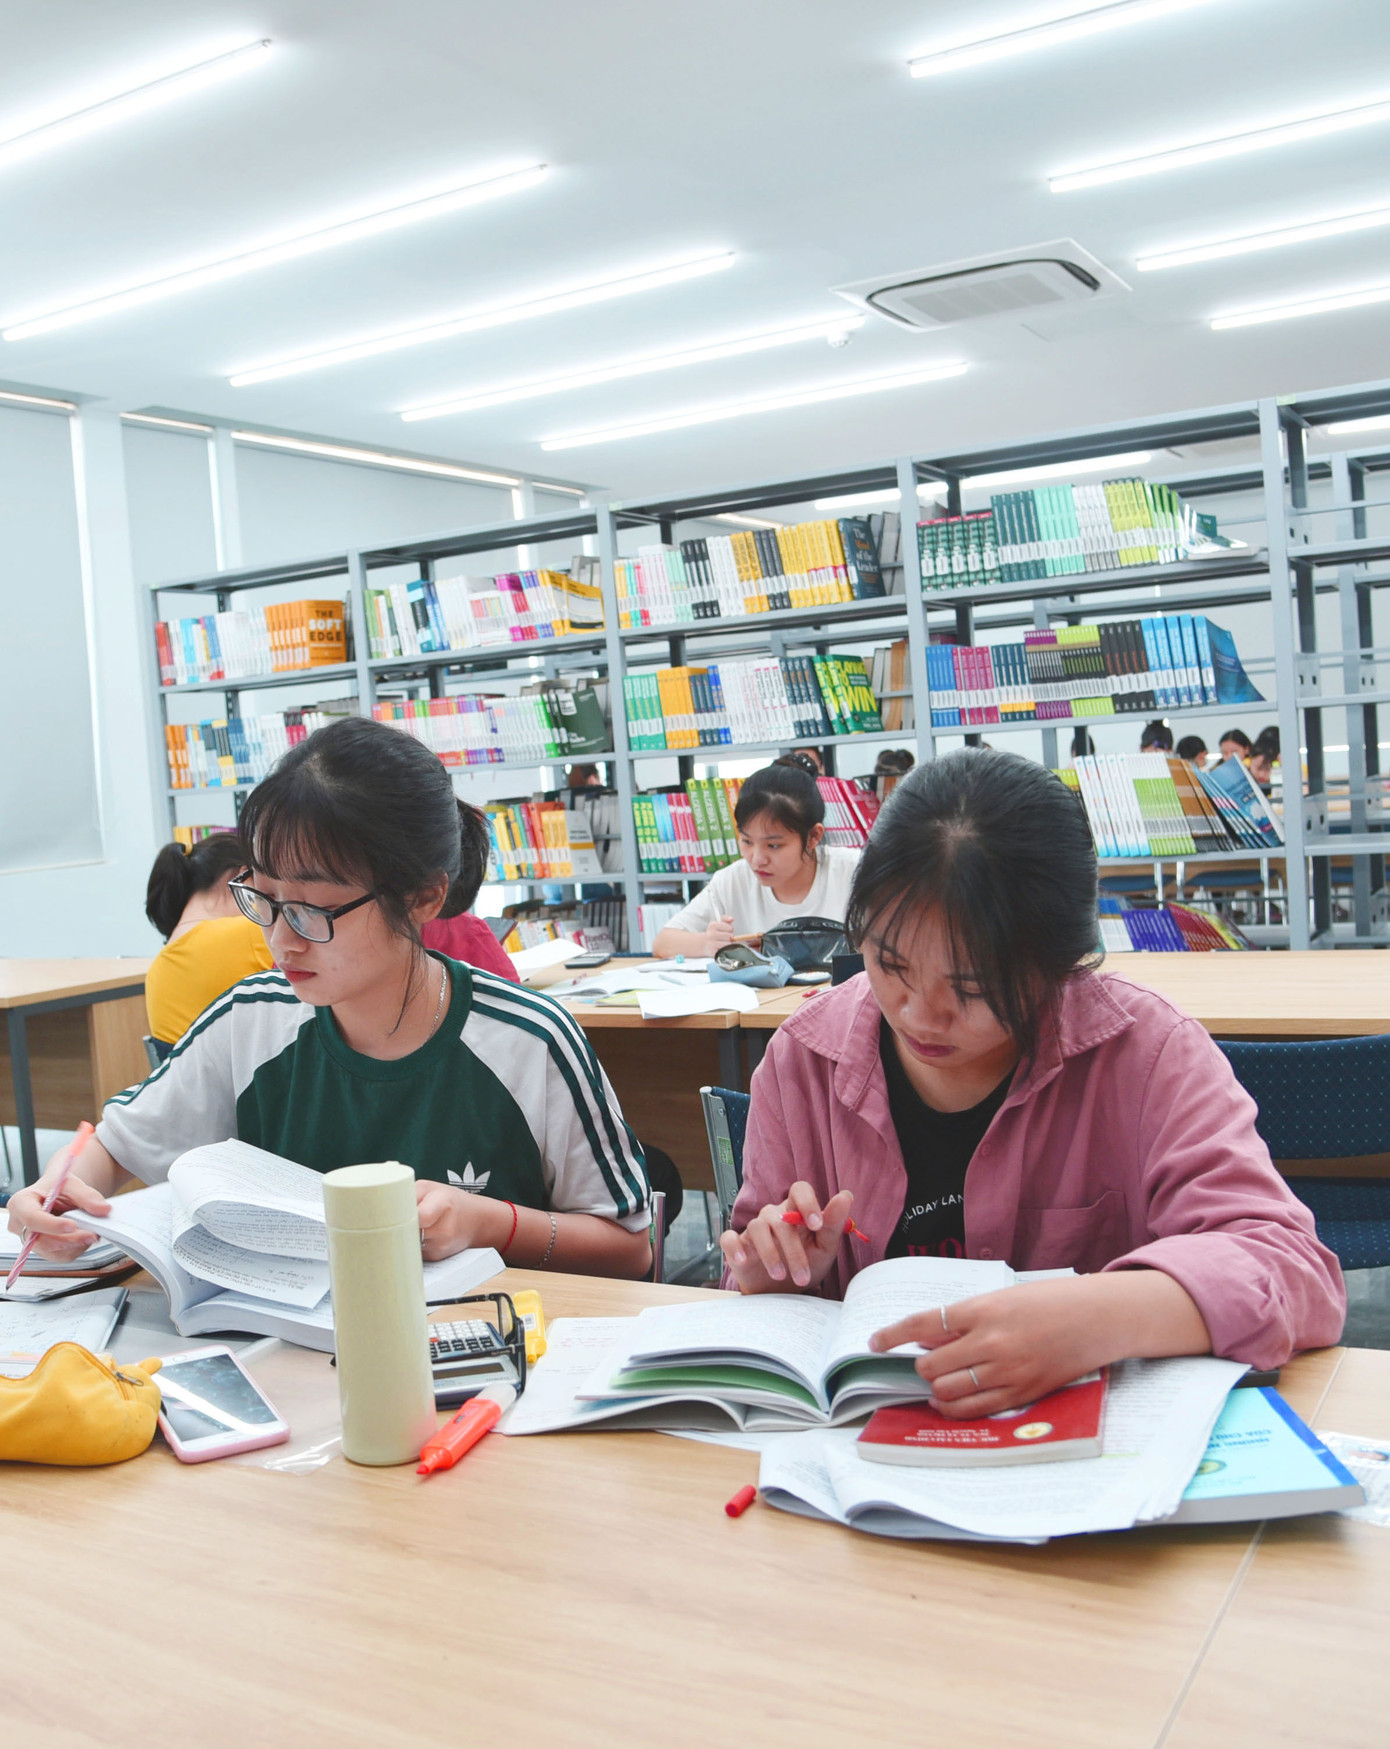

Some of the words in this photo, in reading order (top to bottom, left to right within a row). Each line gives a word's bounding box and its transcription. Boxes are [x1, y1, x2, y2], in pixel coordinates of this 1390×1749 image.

[315, 610, 333, 618] THE
[309, 618, 342, 631] SOFT
[309, 631, 342, 642] EDGE
[842, 686, 878, 713] WIN
[716, 789, 729, 823] ALGEBRA
[902, 1199, 938, 1234] HOLIDAY
